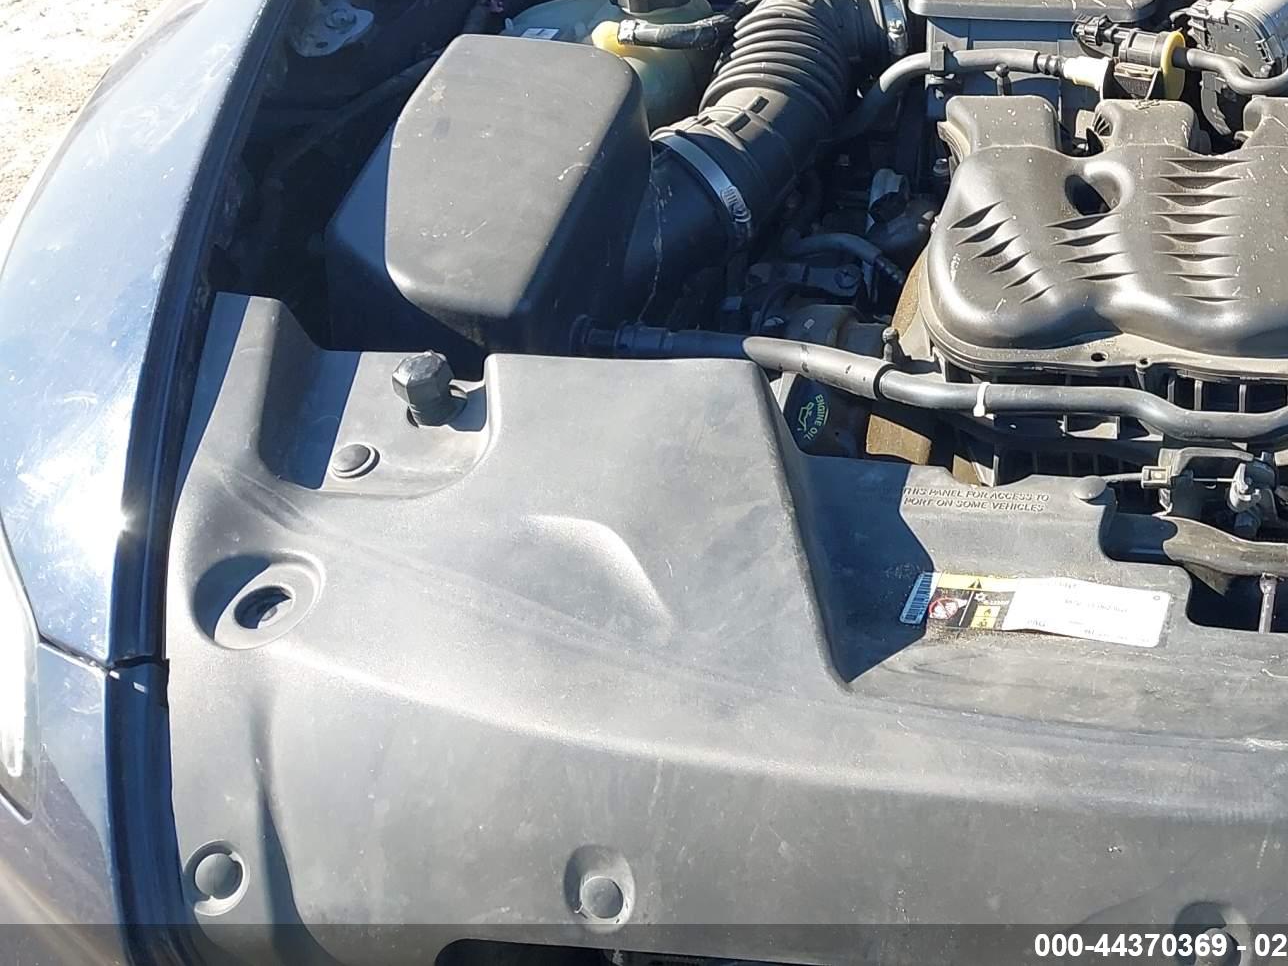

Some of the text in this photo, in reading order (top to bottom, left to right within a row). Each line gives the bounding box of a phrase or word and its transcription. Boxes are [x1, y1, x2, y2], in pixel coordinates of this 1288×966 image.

[803, 394, 826, 440] ENGINE OIL
[928, 488, 963, 498] PANEL
[966, 490, 988, 499] FOR
[990, 492, 1033, 502] ACCESS
[1036, 494, 1050, 503] TO
[904, 497, 1045, 512] PORT ON SOME VEHICLES
